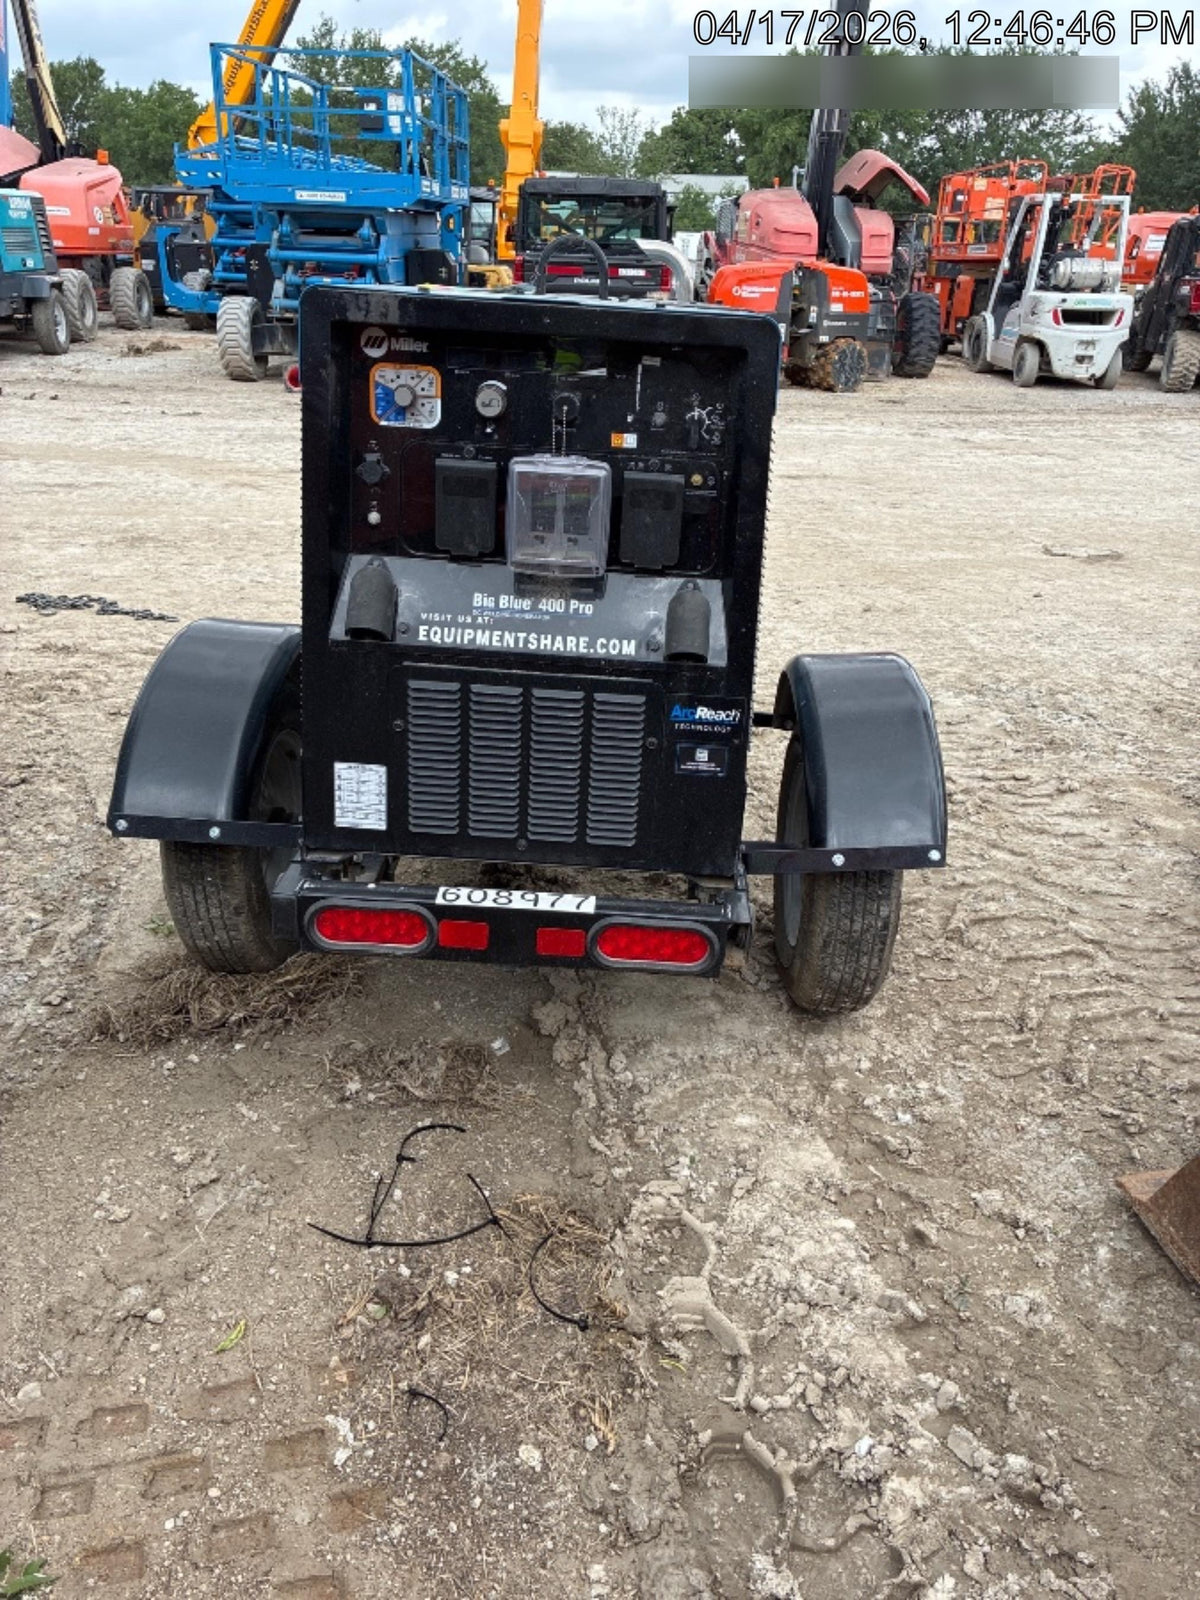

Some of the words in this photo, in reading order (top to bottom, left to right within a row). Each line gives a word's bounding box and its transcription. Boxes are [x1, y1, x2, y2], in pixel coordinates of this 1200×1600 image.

[390, 336, 430, 353] Miller
[472, 592, 496, 609] Big
[499, 594, 531, 611] Blue
[538, 597, 565, 613] 400
[569, 600, 593, 615] Pro
[420, 612, 453, 622] VISIT
[457, 614, 472, 624] US
[475, 615, 494, 625] AT:
[417, 624, 637, 656] EQUIPMENTSHARE.COM
[670, 704, 741, 722] ArcReach
[674, 722, 732, 733] TECHNOLOGY
[441, 888, 592, 911] 608977
